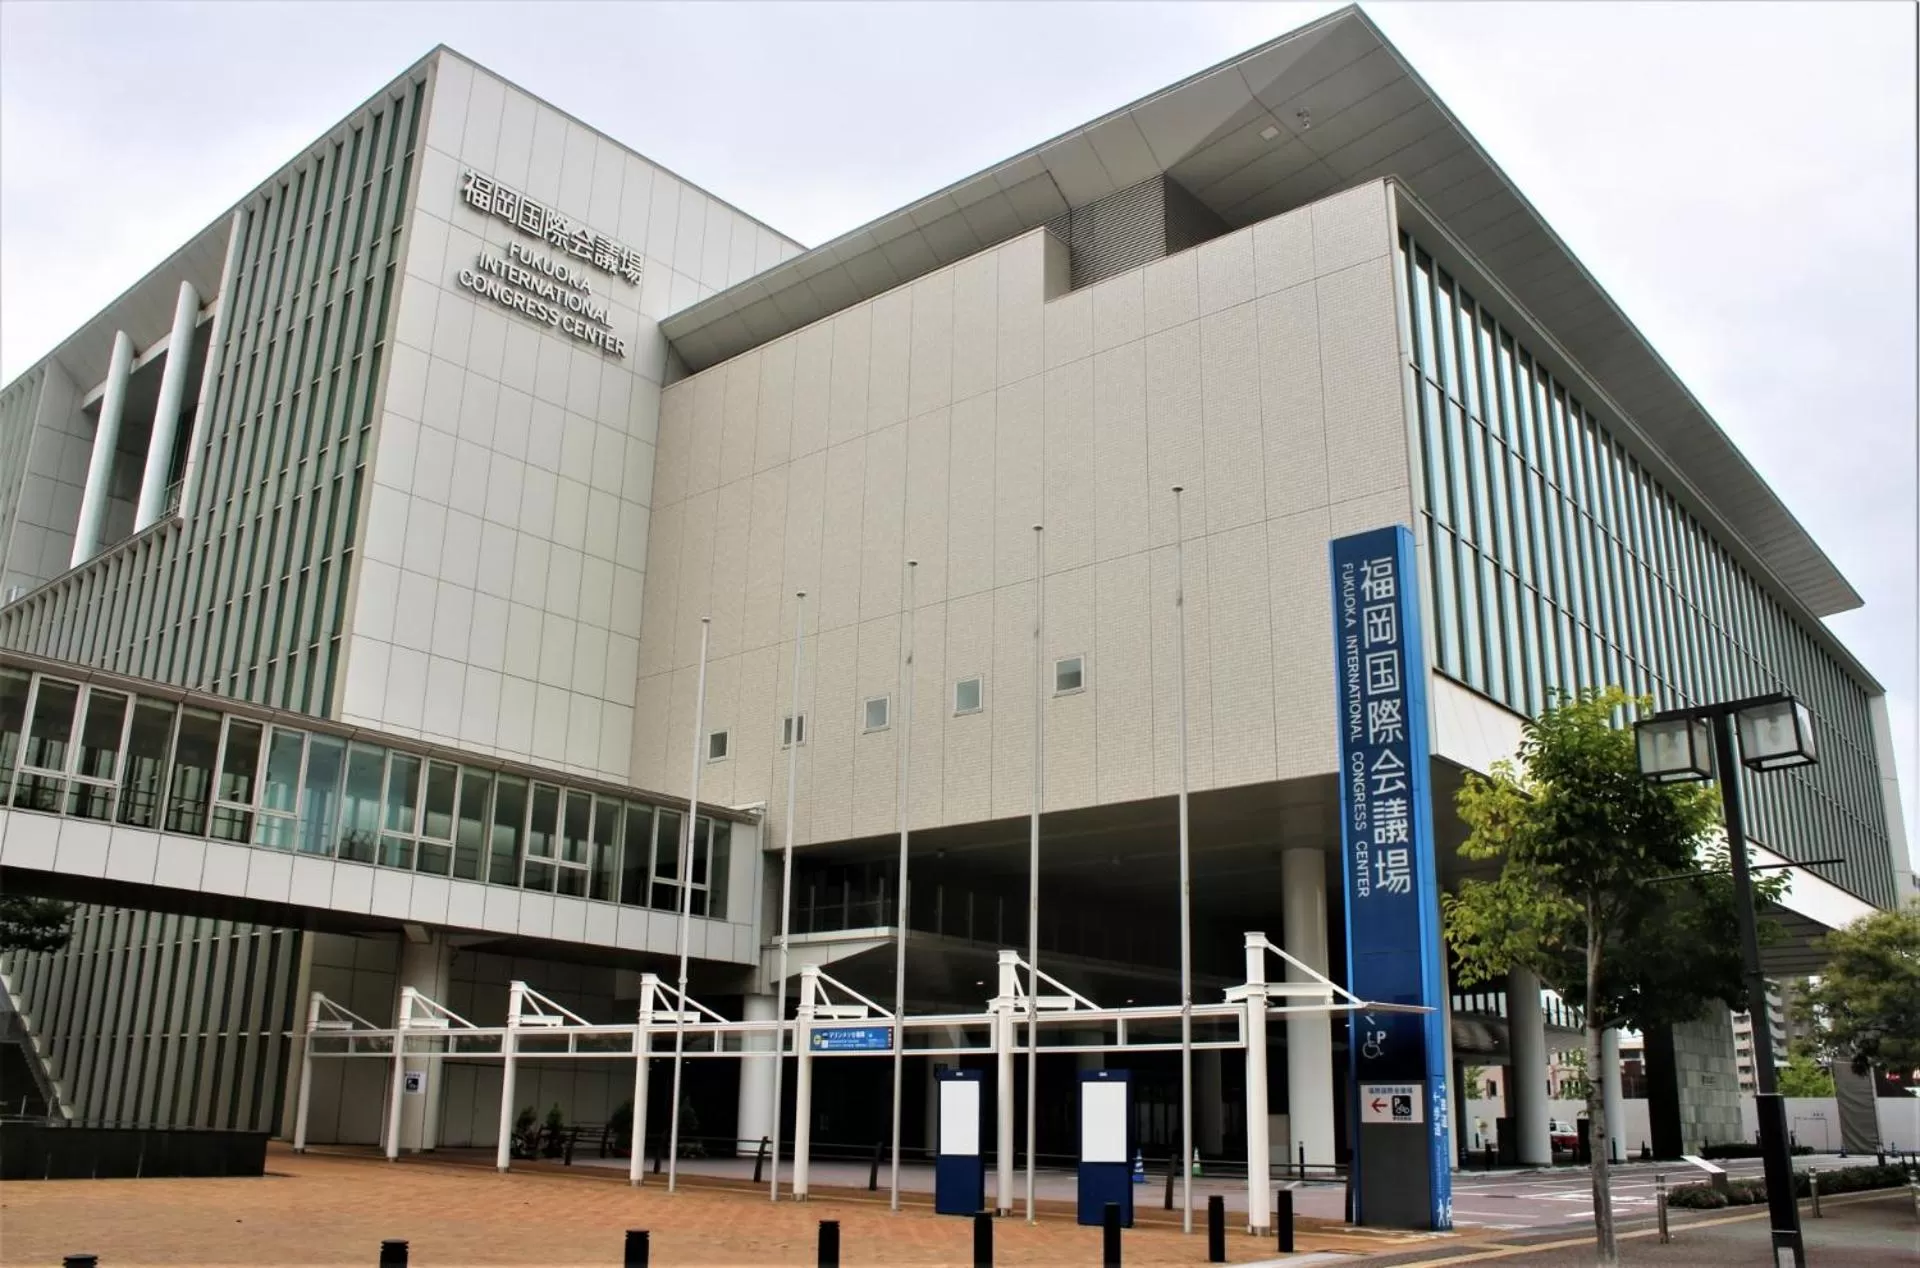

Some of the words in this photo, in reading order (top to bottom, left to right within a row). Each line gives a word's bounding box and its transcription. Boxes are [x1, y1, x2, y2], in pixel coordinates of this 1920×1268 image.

[463, 169, 645, 286] 福岡国際会議場
[479, 252, 614, 329] INTERNATIONAL
[509, 241, 592, 295] FUKUOKA
[459, 268, 560, 327] CONGRESS
[562, 315, 626, 359] CENTER
[1342, 562, 1357, 629] FUKUOKA
[1346, 634, 1363, 743] INTERNATIONAL
[1360, 556, 1411, 894] 福岡国際会議場
[1352, 751, 1367, 832] CONGRESS
[1356, 841, 1370, 898] CENTER
[1376, 1030, 1386, 1044] P
